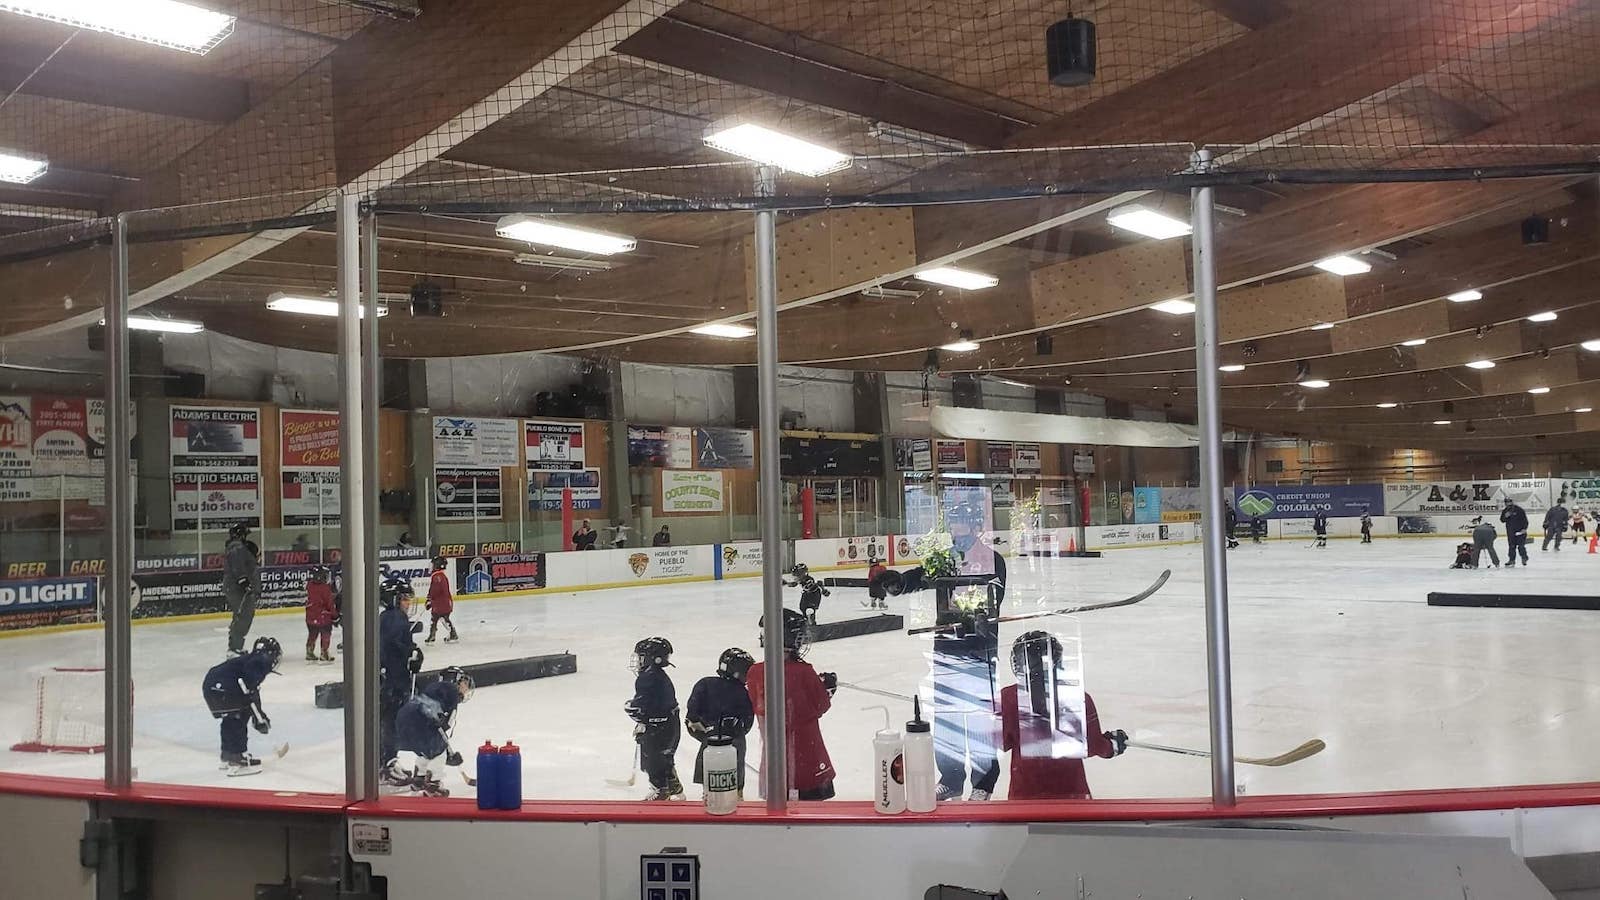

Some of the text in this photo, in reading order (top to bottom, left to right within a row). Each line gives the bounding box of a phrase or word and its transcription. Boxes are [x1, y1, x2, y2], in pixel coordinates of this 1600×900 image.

[174, 410, 256, 421] ADAMS ELECTRIC
[320, 447, 340, 460] Bul
[174, 473, 257, 483] STUDIO SHARE
[1428, 484, 1490, 501] A & K
[177, 500, 255, 512] studio share
[379, 548, 424, 558] BUD LIGHT
[439, 542, 517, 557] BEER GARDEN
[137, 560, 161, 569] BUD
[163, 558, 196, 568] LIGHT
[273, 552, 310, 565] THING
[660, 557, 685, 565] PUEBLO
[8, 562, 47, 577] BEER
[261, 569, 313, 583] Eric Knig
[492, 563, 539, 577] STORAGE
[19, 582, 87, 604] LIGHT
[142, 583, 224, 596] ANDERSON CHIROPRAC
